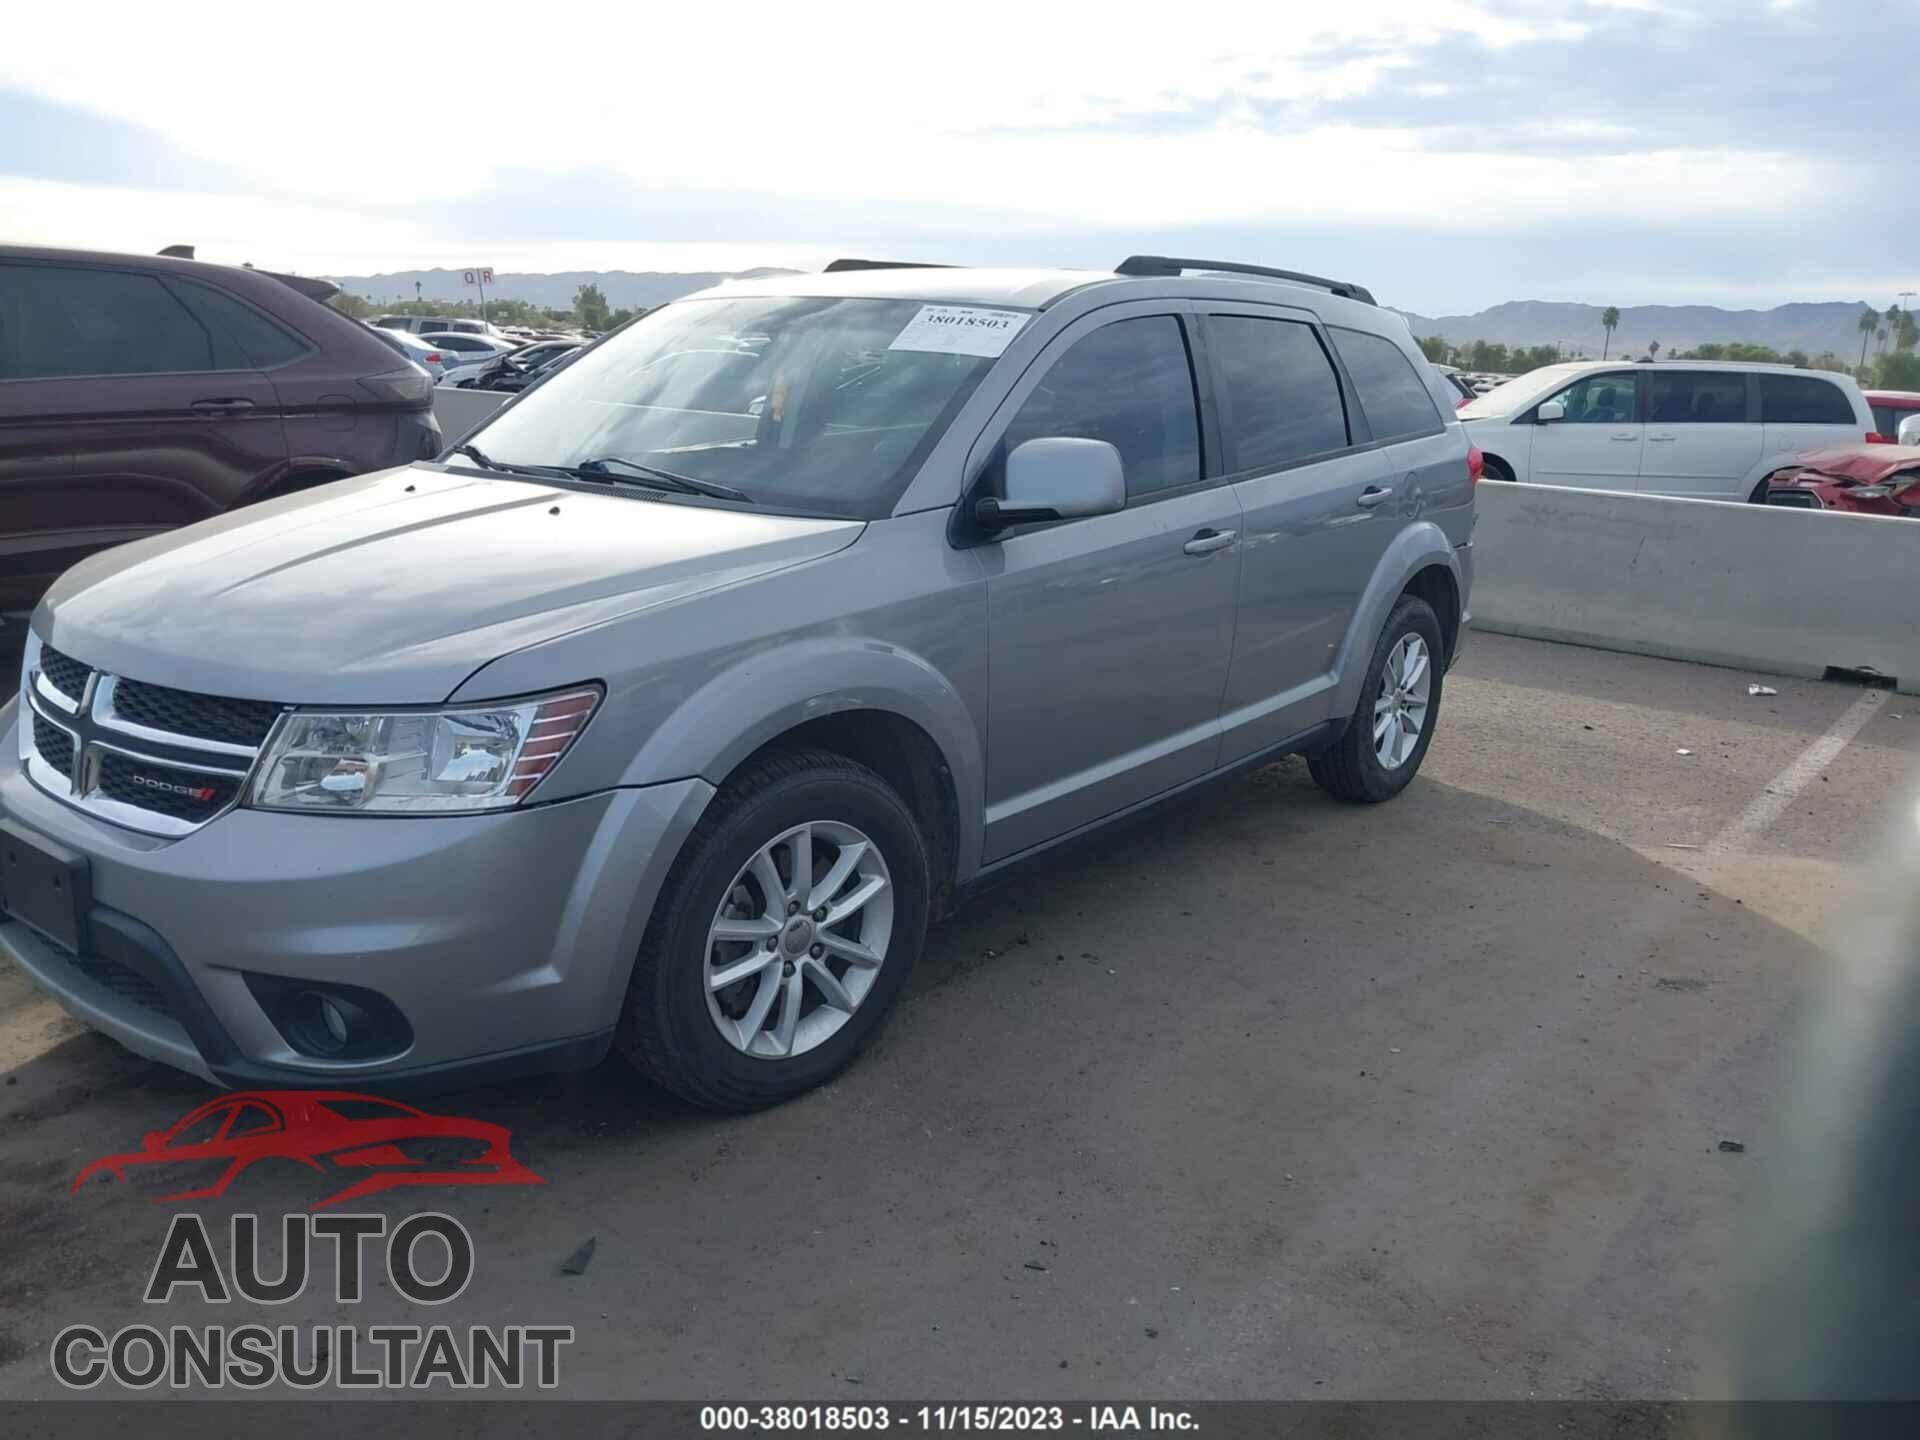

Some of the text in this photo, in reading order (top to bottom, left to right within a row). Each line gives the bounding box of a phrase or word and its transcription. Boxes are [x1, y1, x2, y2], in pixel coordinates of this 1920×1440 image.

[464, 271, 492, 284] Q R
[133, 775, 202, 797] DODGE
